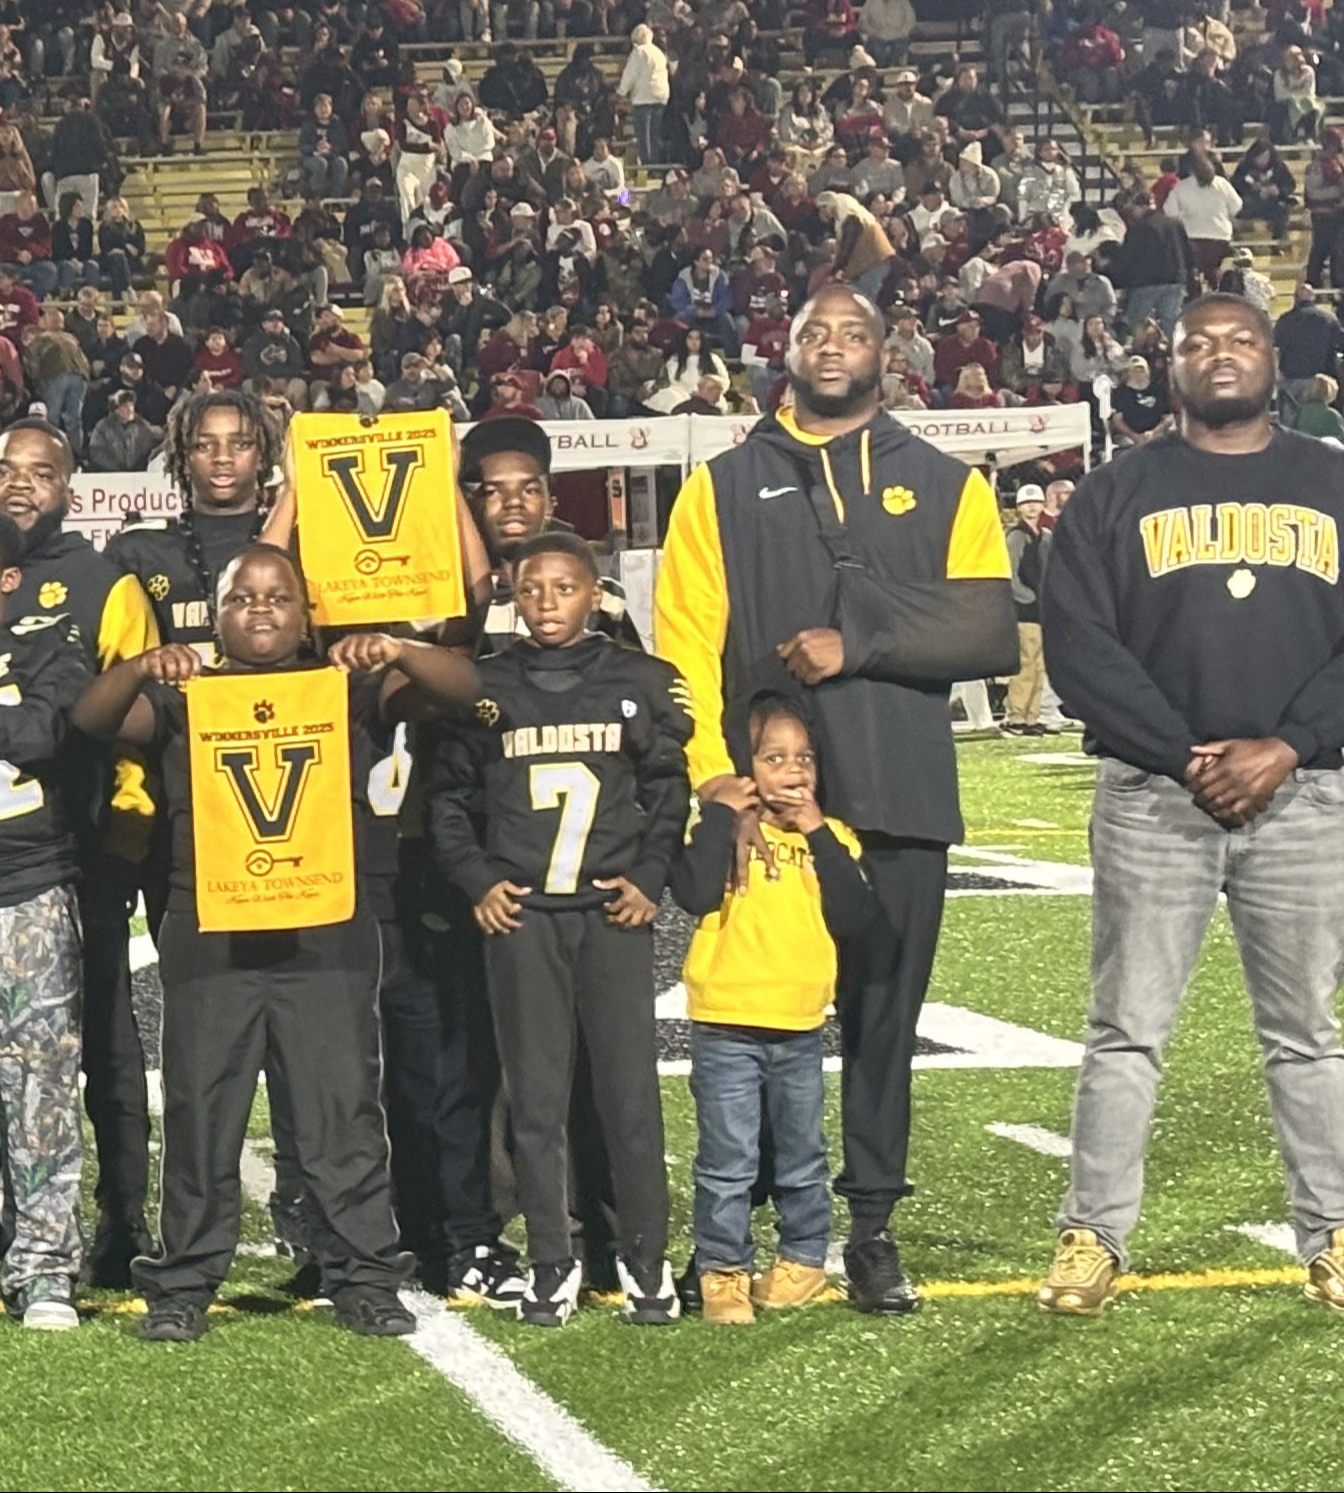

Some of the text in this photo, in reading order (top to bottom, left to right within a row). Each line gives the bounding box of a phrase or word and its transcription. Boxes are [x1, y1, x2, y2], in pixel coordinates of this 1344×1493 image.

[551, 433, 618, 449] BALL
[909, 421, 1010, 436] OOTBALL
[92, 487, 187, 514] Produc
[320, 443, 425, 545] V
[1140, 502, 1339, 585] VALDOSTA
[501, 722, 623, 758] VALDOSTA
[213, 739, 322, 845] V
[529, 761, 601, 894] 7
[207, 872, 344, 893] LAKEYA TOWNSEND
